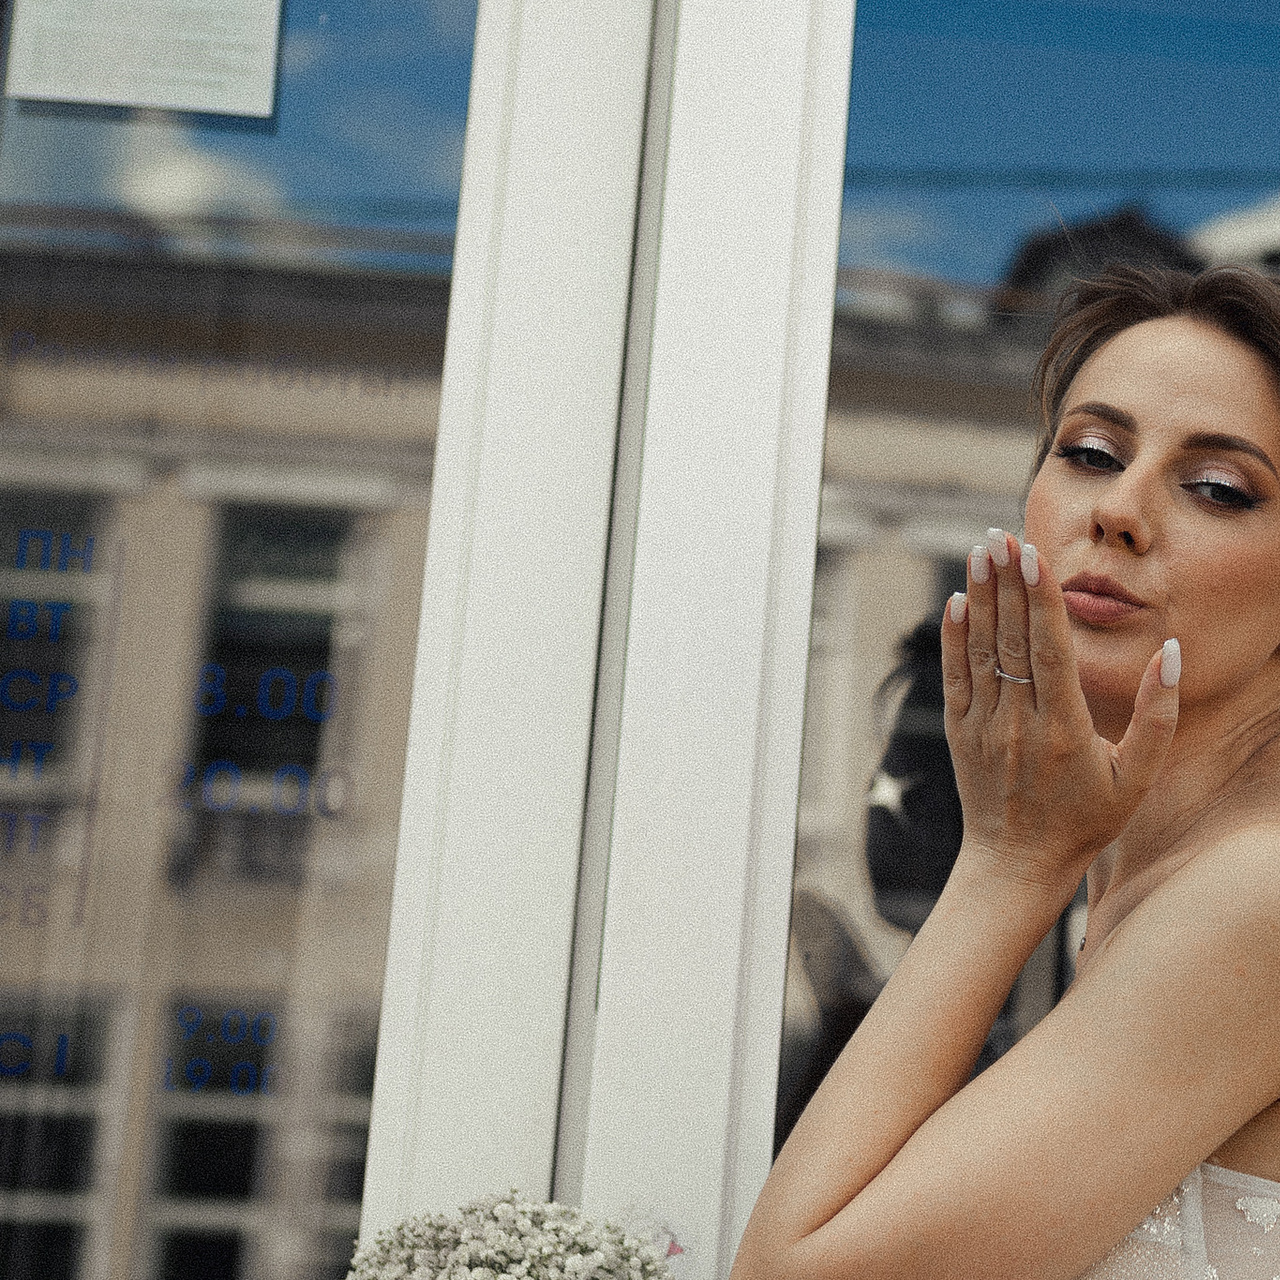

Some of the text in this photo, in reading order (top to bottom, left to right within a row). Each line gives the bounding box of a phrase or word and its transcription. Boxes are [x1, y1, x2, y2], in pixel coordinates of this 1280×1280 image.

[15, 528, 95, 574] ПН
[7, 599, 73, 644] ВТ
[0, 669, 80, 714] СР
[178, 1006, 277, 1046] 9.00
